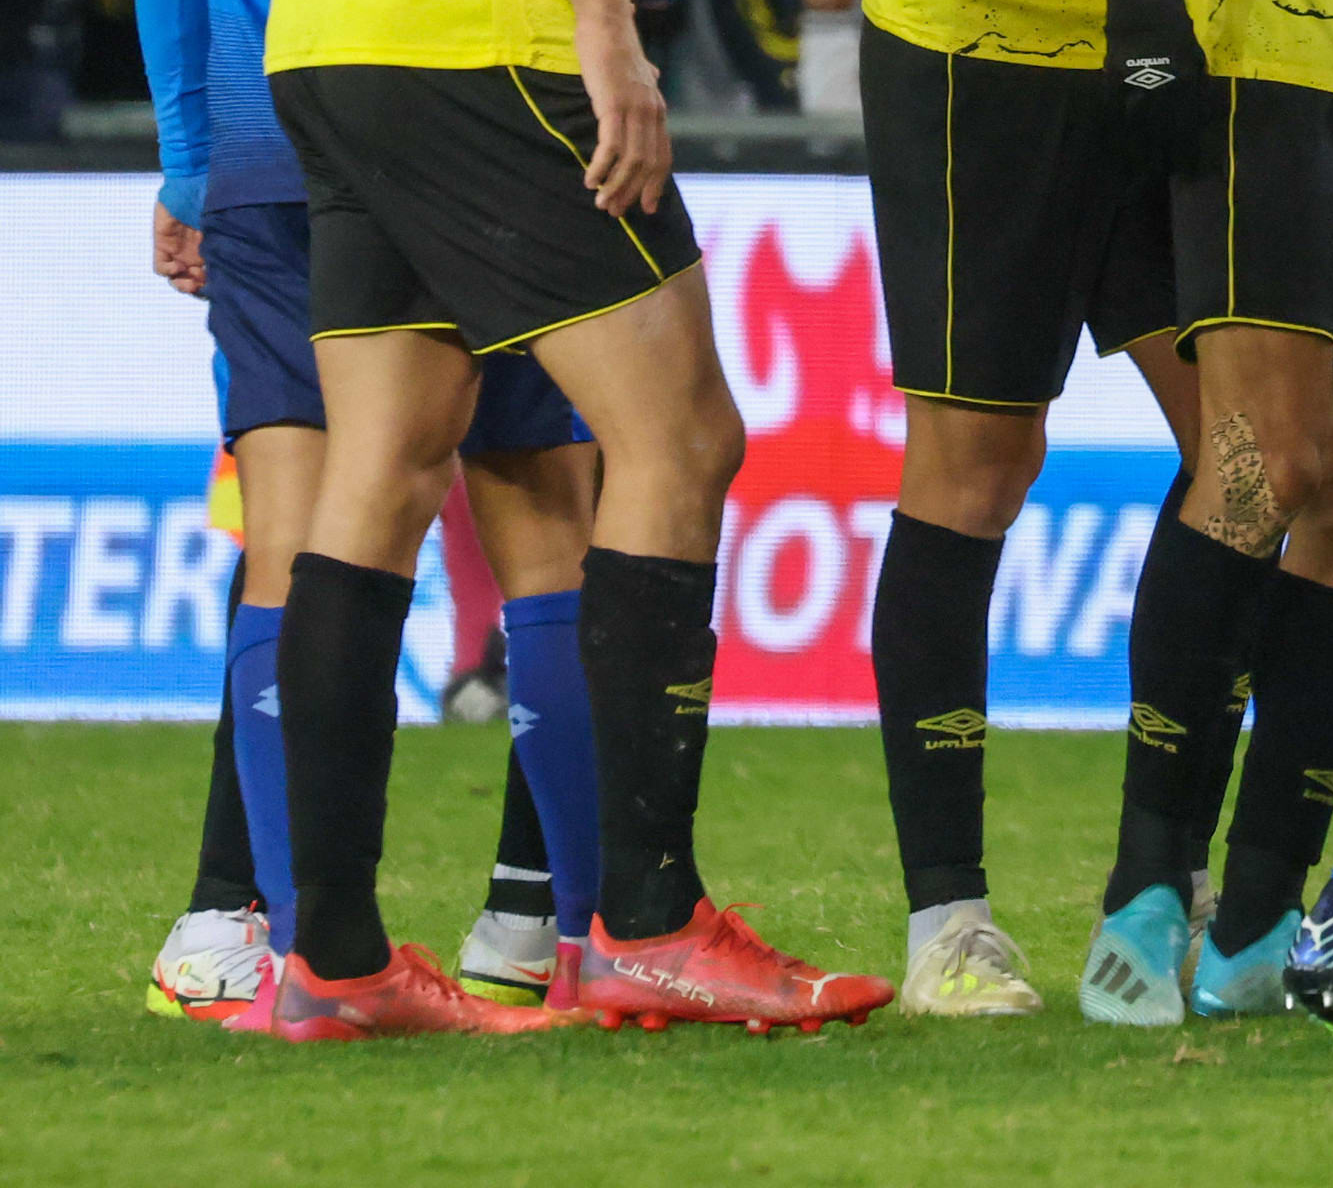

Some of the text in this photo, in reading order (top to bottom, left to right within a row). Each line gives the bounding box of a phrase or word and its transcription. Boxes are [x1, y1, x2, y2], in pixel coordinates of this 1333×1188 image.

[1126, 57, 1170, 68] umbro
[0, 496, 228, 648] TER
[613, 957, 715, 1008] ULTRA
